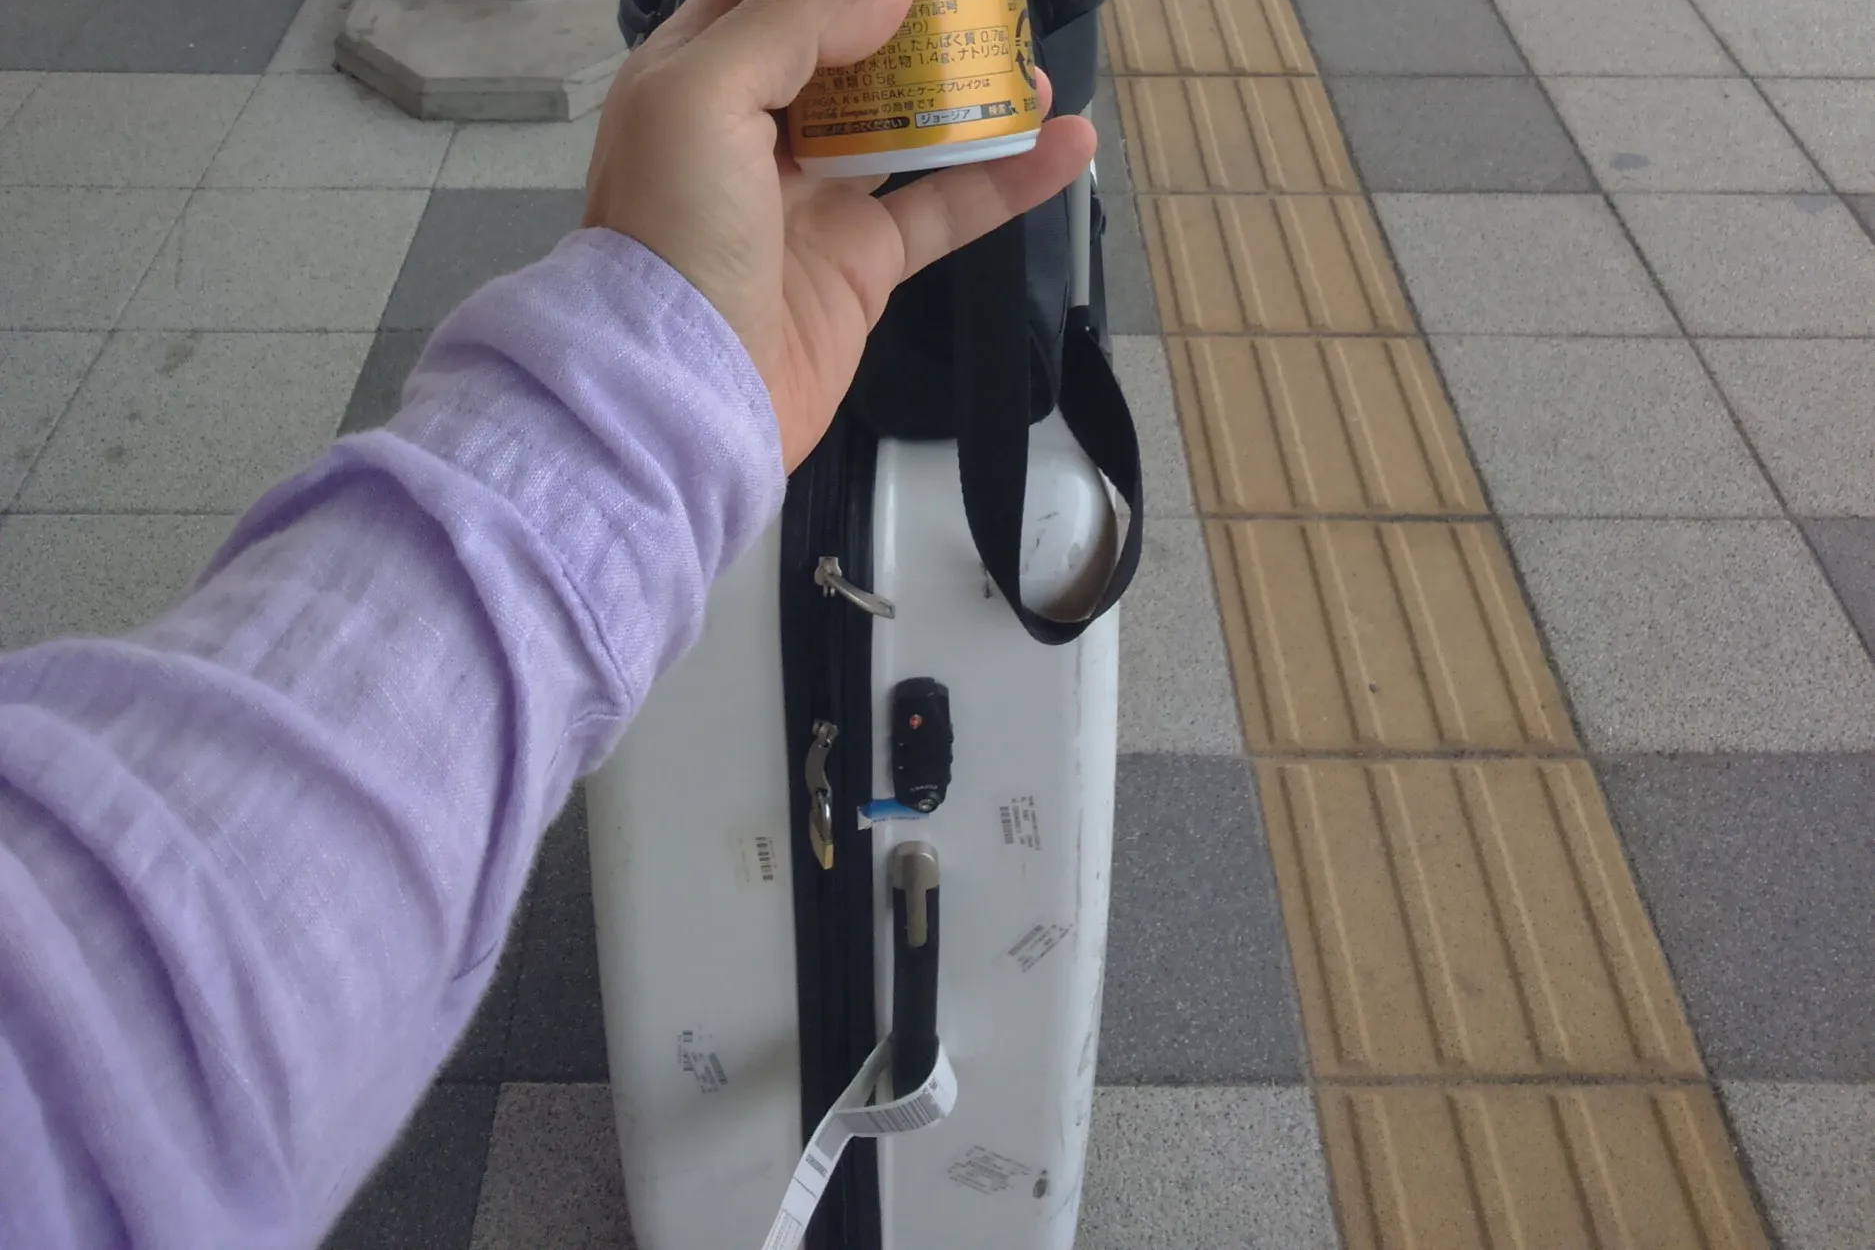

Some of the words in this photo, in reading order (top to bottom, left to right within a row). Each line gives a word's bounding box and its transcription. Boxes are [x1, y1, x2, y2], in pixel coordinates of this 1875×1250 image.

[920, 107, 972, 125] ジョージア
